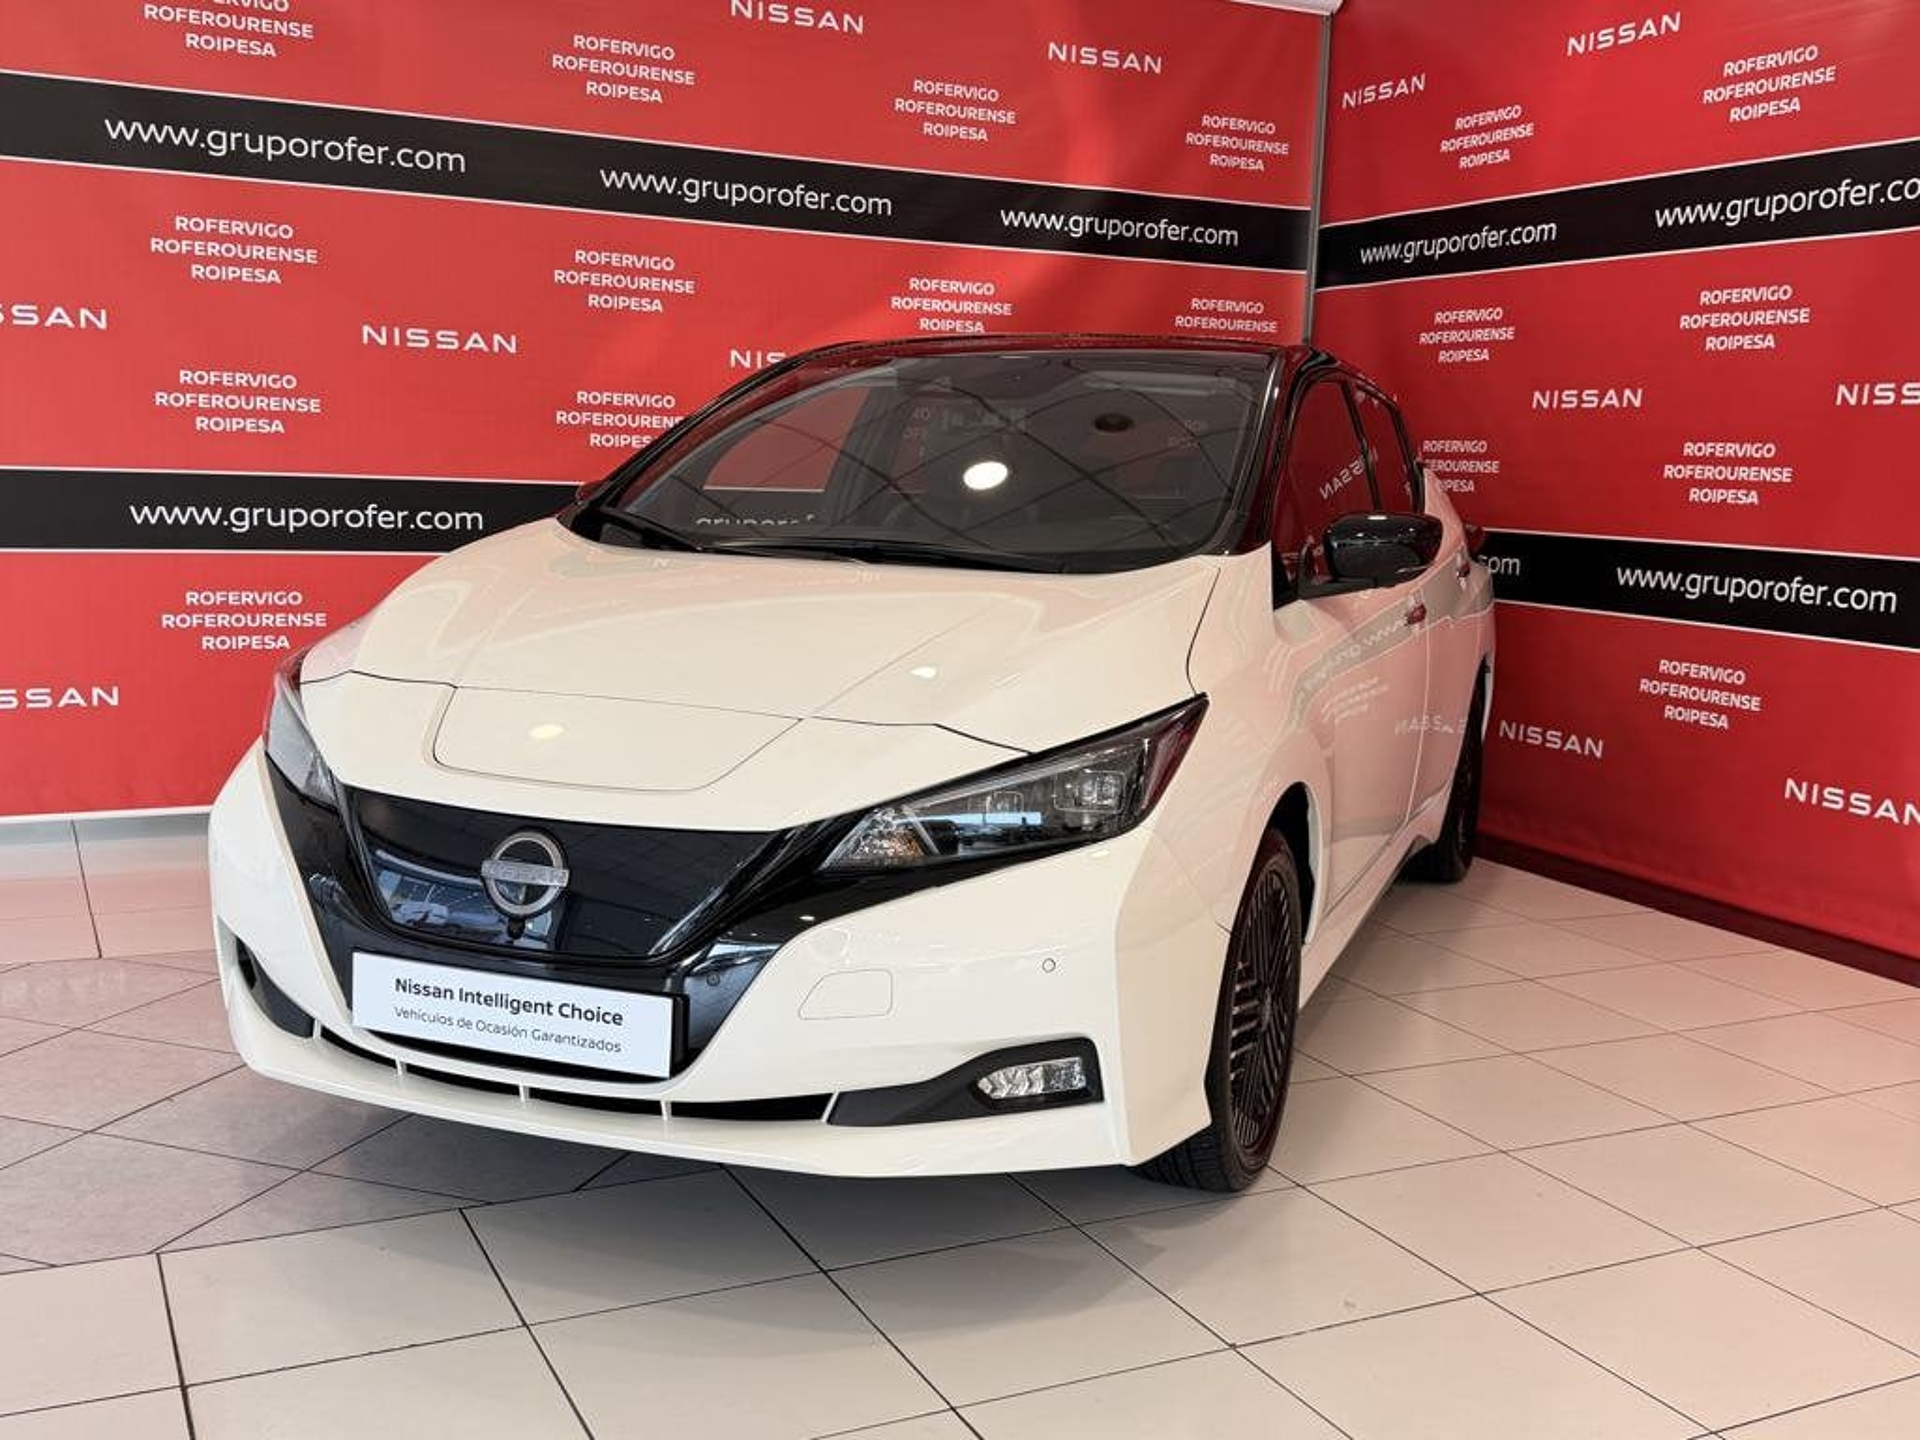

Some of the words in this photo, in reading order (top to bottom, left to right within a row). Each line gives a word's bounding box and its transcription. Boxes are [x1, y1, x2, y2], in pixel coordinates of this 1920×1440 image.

[143, 3, 314, 39] ROFEROURENSE
[730, 0, 864, 34] NISSAN
[185, 32, 277, 57] ROIPESA
[1567, 11, 1681, 56] NISSAN
[573, 34, 676, 61] ROFERVIGO
[1047, 41, 1162, 74] NISSAN
[552, 53, 695, 85] ROFEROURENSE
[1723, 44, 1819, 77] ROFERVIGO
[586, 80, 663, 103] ROIPESA
[913, 79, 1000, 102] ROFERVIGO
[1342, 73, 1426, 109] NISSAN
[1703, 65, 1837, 104] ROFEROURENSE
[894, 97, 1016, 125] ROFEROURENSE
[1454, 104, 1522, 130] ROFERVIGO
[1729, 96, 1801, 123] ROIPESA
[923, 121, 989, 142] ROIPESA
[1201, 114, 1276, 135] ROFERVIGO
[104, 119, 466, 173] www.gruporofer.com
[1185, 132, 1289, 155] ROFEROURENSE
[1439, 122, 1535, 153] ROFEROURENSE
[1209, 153, 1265, 172] ROIPESA
[1459, 148, 1511, 169] ROIPESA
[599, 169, 892, 216] www.gruporofer.com
[1655, 177, 1920, 228] www.gruporofer.co
[174, 215, 294, 239] ROFERVIGO
[1000, 209, 1239, 246] www.gruporofer.com
[150, 237, 318, 264] ROFEROURENSE
[1360, 222, 1558, 264] www.gruporofer.com
[574, 249, 676, 271] ROFERVIGO
[191, 263, 282, 284] ROIPESA
[554, 269, 695, 294] ROFEROURENSE
[909, 277, 995, 296] ROFERVIGO
[1699, 284, 1793, 306] ROFERVIGO
[588, 293, 663, 313] ROIPESA
[891, 296, 1012, 316] ROFEROURENSE
[1190, 297, 1265, 314] ROFERVIGO
[0, 303, 107, 330] SAN
[919, 317, 985, 334] ROIPESA
[1174, 314, 1277, 333] ROFEROURENSE
[1434, 306, 1503, 325] ROFERVIGO
[1679, 307, 1810, 329] ROFEROURENSE
[362, 324, 517, 354] NISSAN
[1419, 326, 1515, 344] ROFEROURENSE
[1705, 333, 1776, 351] ROIPESA
[1438, 348, 1490, 363] ROIPESA
[179, 369, 297, 389] ROFERVIGO
[155, 391, 321, 413] ROFEROURENSE
[576, 390, 676, 409] ROFERVIGO
[1532, 388, 1643, 409] NISSAN
[1836, 382, 1920, 406] NISS
[195, 416, 285, 434] ROIPESA
[589, 432, 653, 449] ROIPES
[1422, 439, 1488, 453] ROFERVIGO
[1683, 441, 1776, 459] ROFERVIGO
[1663, 464, 1793, 483] ROFEROURENSE
[1688, 487, 1759, 505] ROIPESA
[129, 503, 483, 534] www.gruporofer.com
[185, 591, 303, 606] ROFERVIGO
[1616, 567, 1897, 614] www.gruporofer.com
[161, 612, 327, 629] ROFEROURENSE
[201, 635, 290, 650] ROIPESA
[1658, 659, 1746, 686] ROFERVIGO
[0, 686, 119, 710] SSAN
[1639, 678, 1762, 712] ROFEROURENSE
[1664, 704, 1729, 730] ROIPESA
[1499, 720, 1604, 759] NISSAN
[395, 977, 454, 1001] Nissan
[458, 987, 554, 1017] Intelligent
[558, 1002, 624, 1026] Choice
[394, 1006, 454, 1028] Vehículos
[457, 1016, 473, 1031] de
[476, 1018, 528, 1039] Ocasión
[532, 1029, 623, 1053] Garantizados
